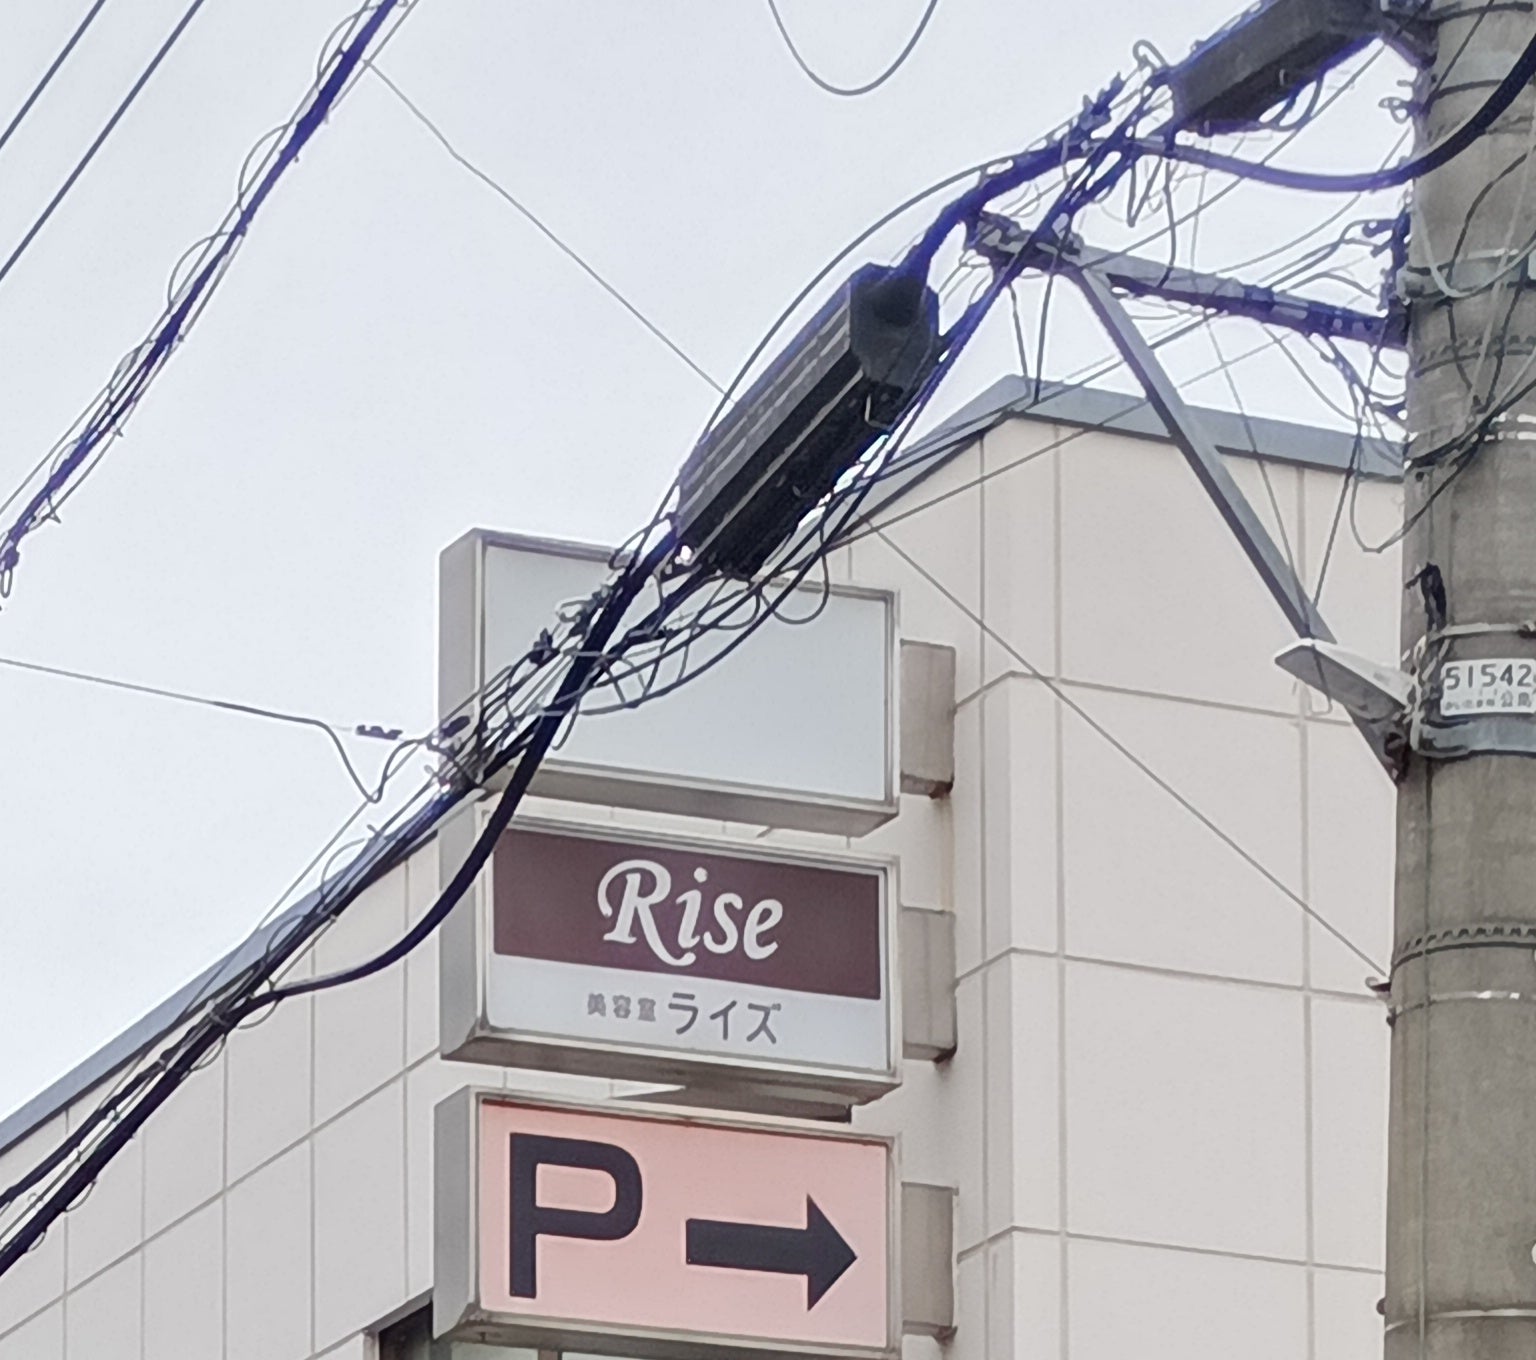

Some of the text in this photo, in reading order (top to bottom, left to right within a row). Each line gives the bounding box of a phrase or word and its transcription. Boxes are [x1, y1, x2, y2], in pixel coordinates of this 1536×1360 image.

[597, 860, 784, 967] Rise
[668, 992, 782, 1045] ライズ
[509, 1132, 644, 1300] P
